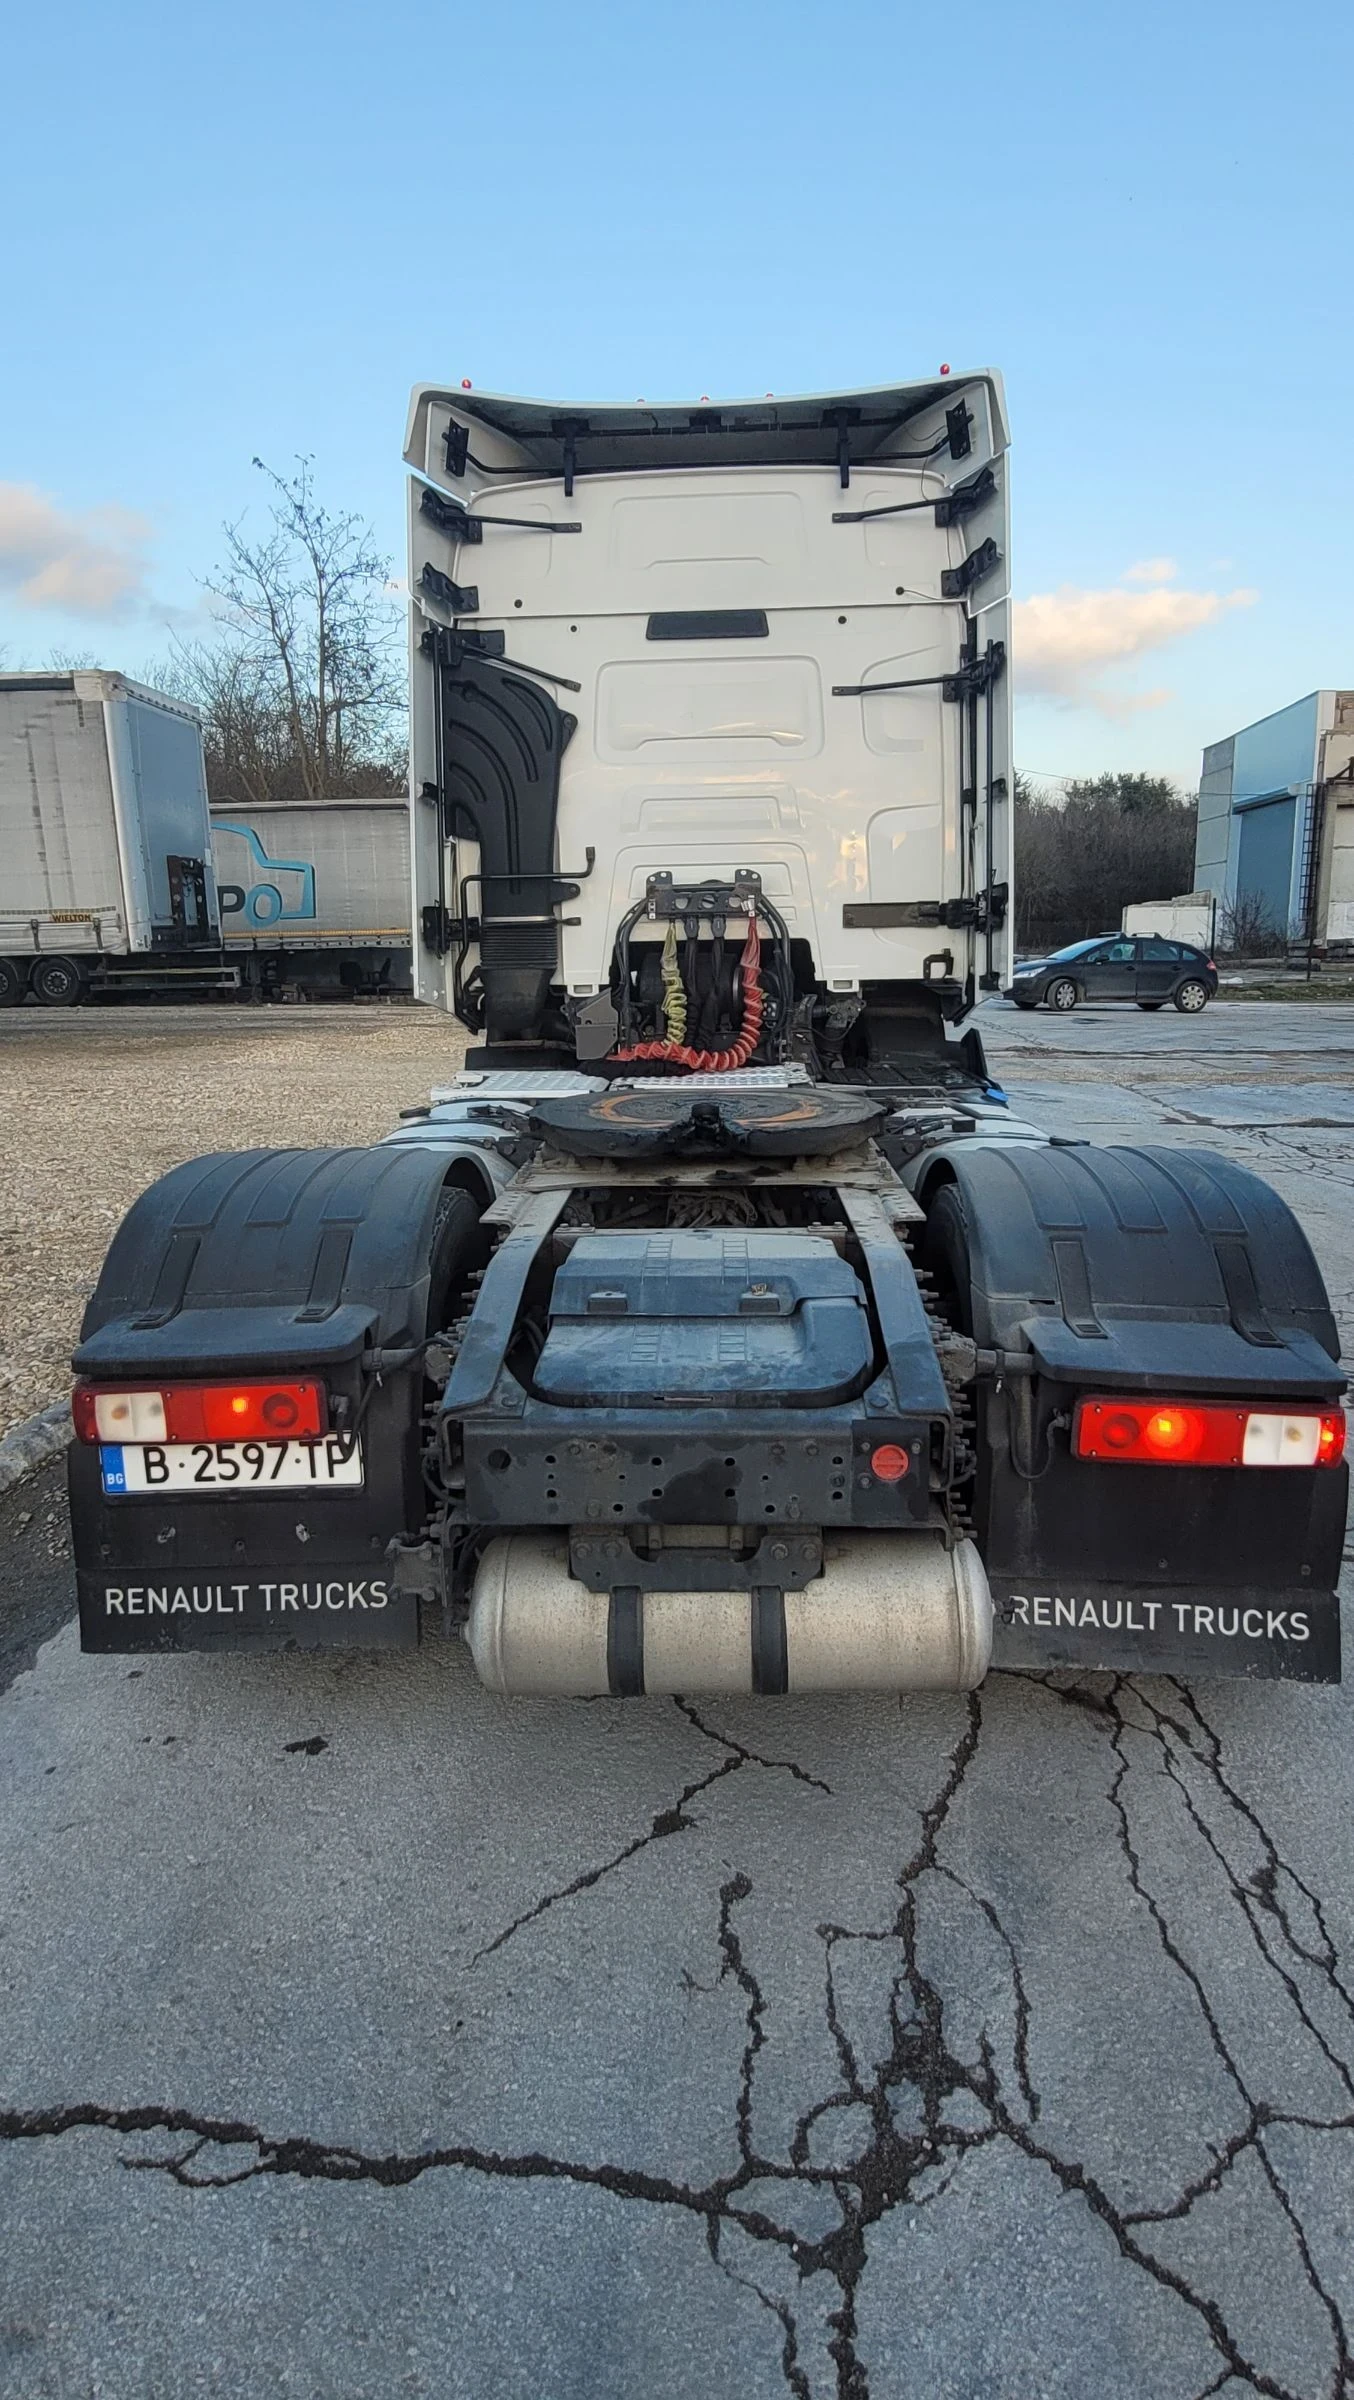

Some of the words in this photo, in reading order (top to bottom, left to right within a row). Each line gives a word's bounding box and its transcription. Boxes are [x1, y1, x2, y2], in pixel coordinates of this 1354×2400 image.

[51, 914, 92, 923] WIELTON
[106, 1473, 125, 1485] BG
[105, 1585, 250, 1615] RENAULT
[259, 1581, 389, 1612] TRUCKS
[1008, 1595, 1162, 1631] RENAULT
[1172, 1603, 1311, 1641] TRUCKS
